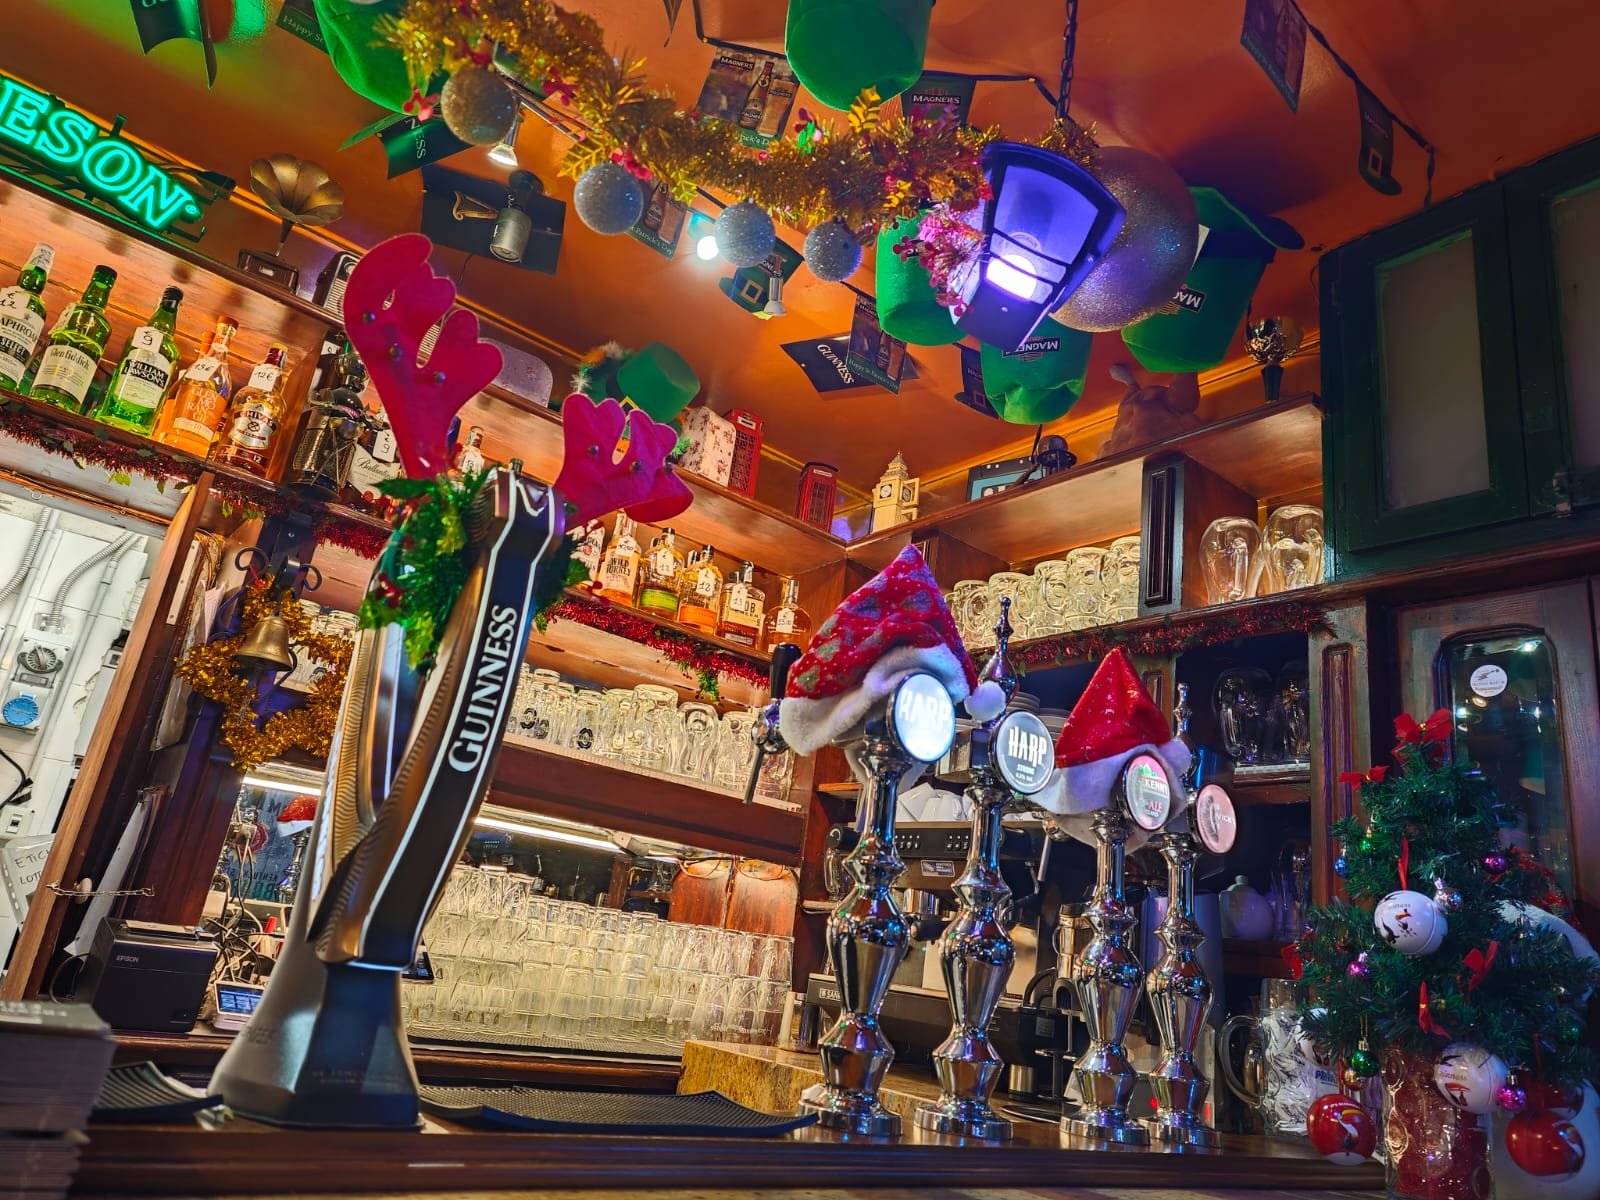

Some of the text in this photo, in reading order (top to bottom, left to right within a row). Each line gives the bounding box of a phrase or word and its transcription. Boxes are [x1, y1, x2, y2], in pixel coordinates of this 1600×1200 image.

[282, 15, 314, 38] Happy
[720, 57, 754, 70] MAGNERS
[913, 95, 961, 104] MAGNERS
[130, 360, 166, 379] WILLIAM
[817, 344, 855, 385] GUINNESS
[605, 564, 632, 577] TURKEY
[610, 557, 631, 568] WILD
[448, 605, 519, 774] GUINNESS
[898, 688, 952, 731] HARP
[1007, 725, 1048, 768] HARP
[115, 954, 140, 963] EPSON
